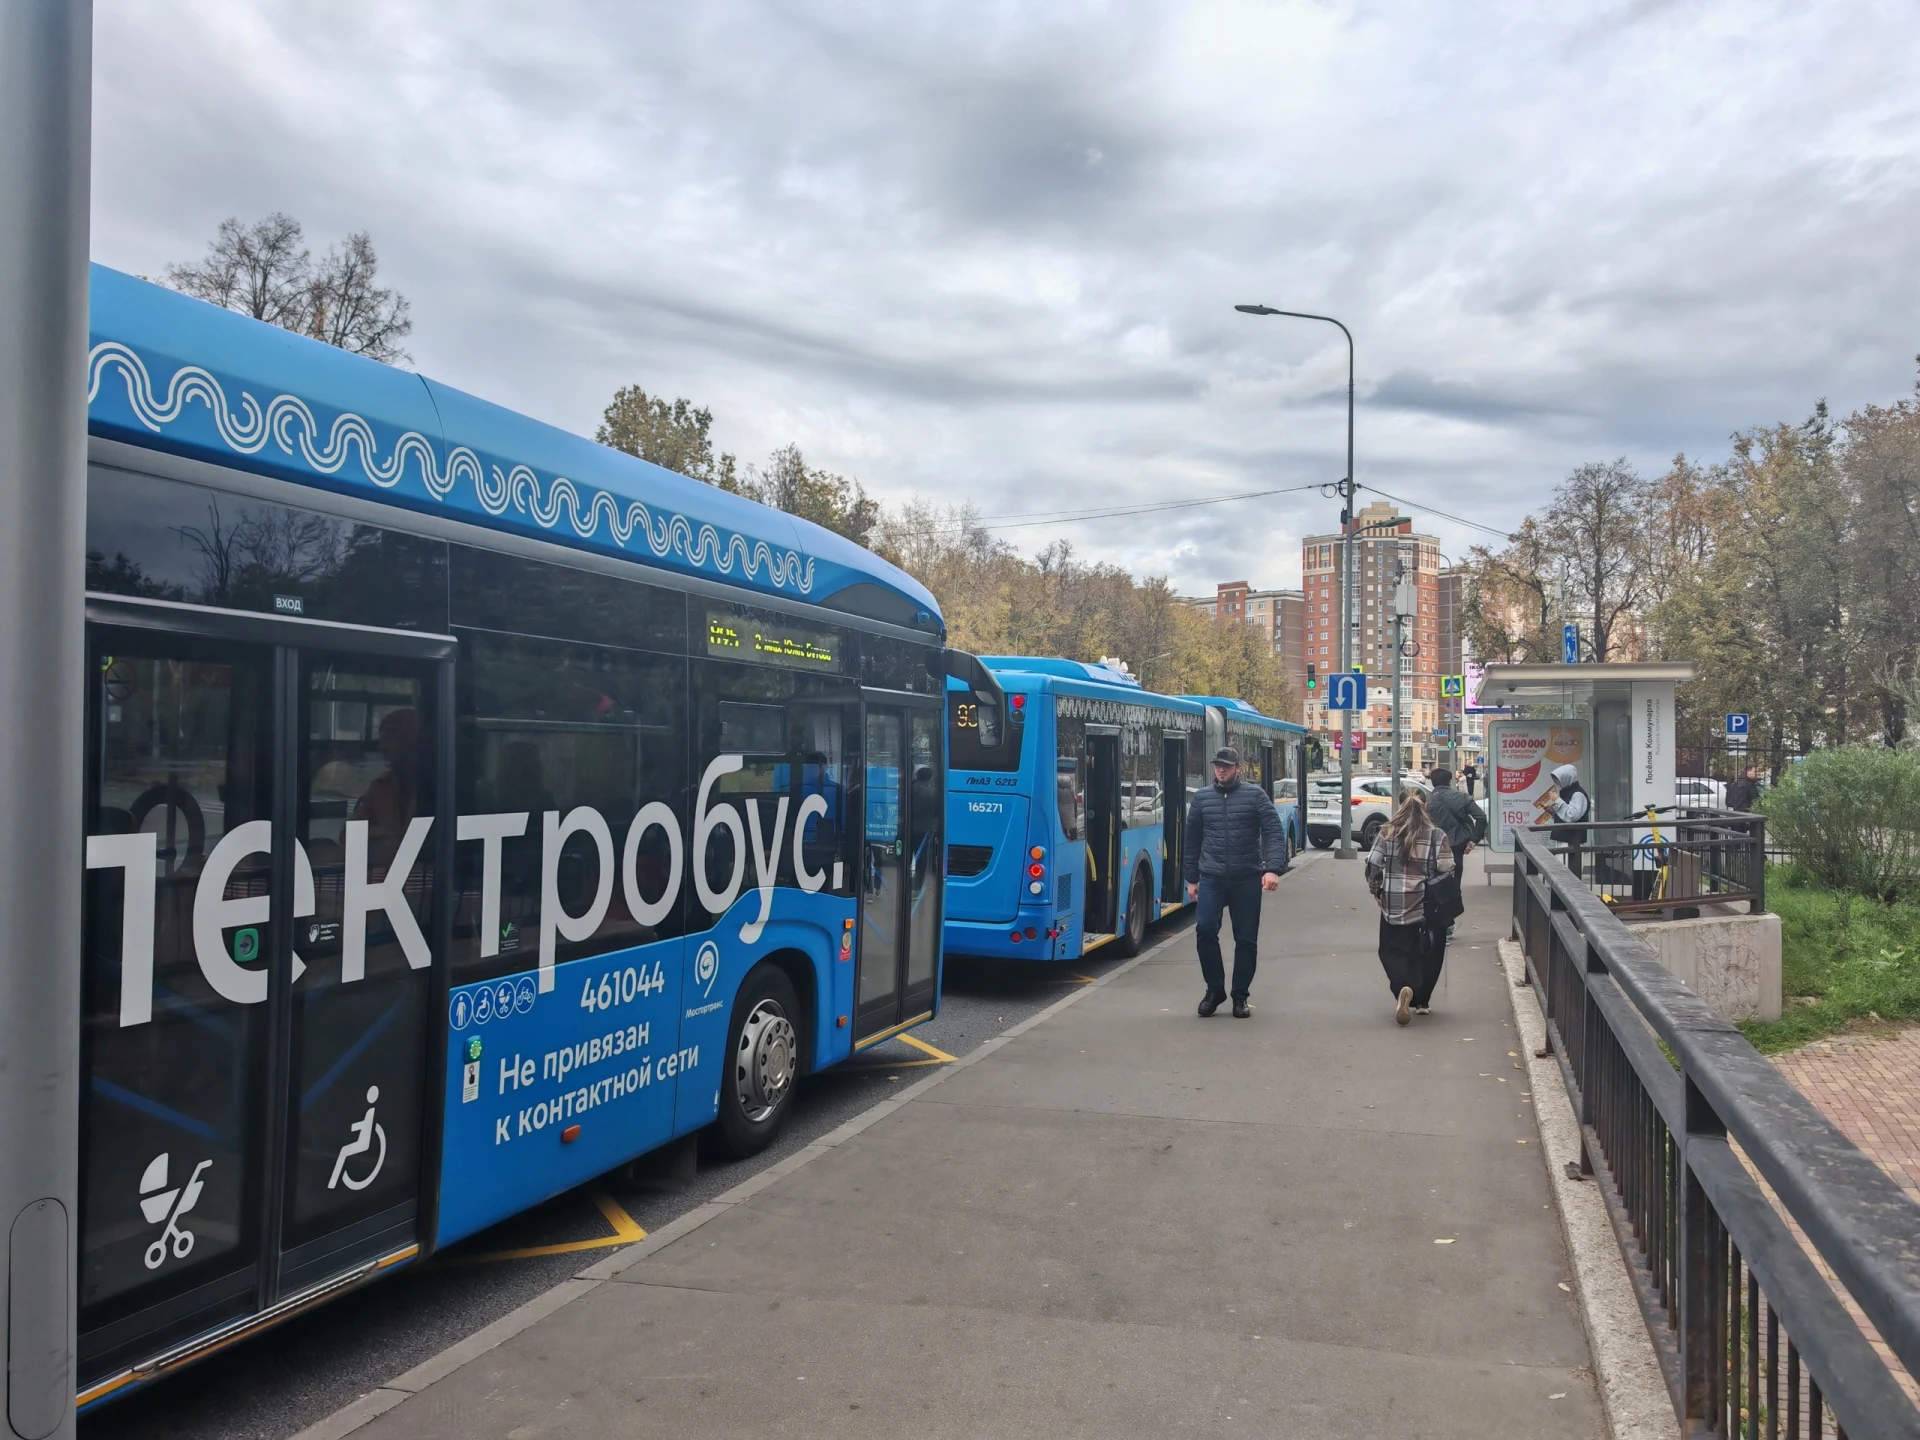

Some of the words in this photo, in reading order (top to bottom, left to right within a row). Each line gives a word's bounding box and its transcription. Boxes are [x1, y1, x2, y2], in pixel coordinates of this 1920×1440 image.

[276, 597, 302, 612] ВХОД
[1645, 699, 1654, 748] Коммунарка
[1732, 716, 1744, 731] P
[1502, 739, 1526, 748] 1000
[1528, 739, 1547, 748] 000
[1645, 751, 1653, 784] Посёлок
[995, 778, 1018, 787] 6213
[968, 802, 1003, 814] 165271
[1502, 811, 1523, 824] 169
[581, 960, 665, 1013] 461044
[685, 1000, 724, 1019] Мосгортранс
[499, 1053, 536, 1095] Не
[543, 1021, 650, 1083] привязан
[495, 1115, 511, 1145] к
[518, 1055, 652, 1137] контактной
[656, 1045, 699, 1081] сети
